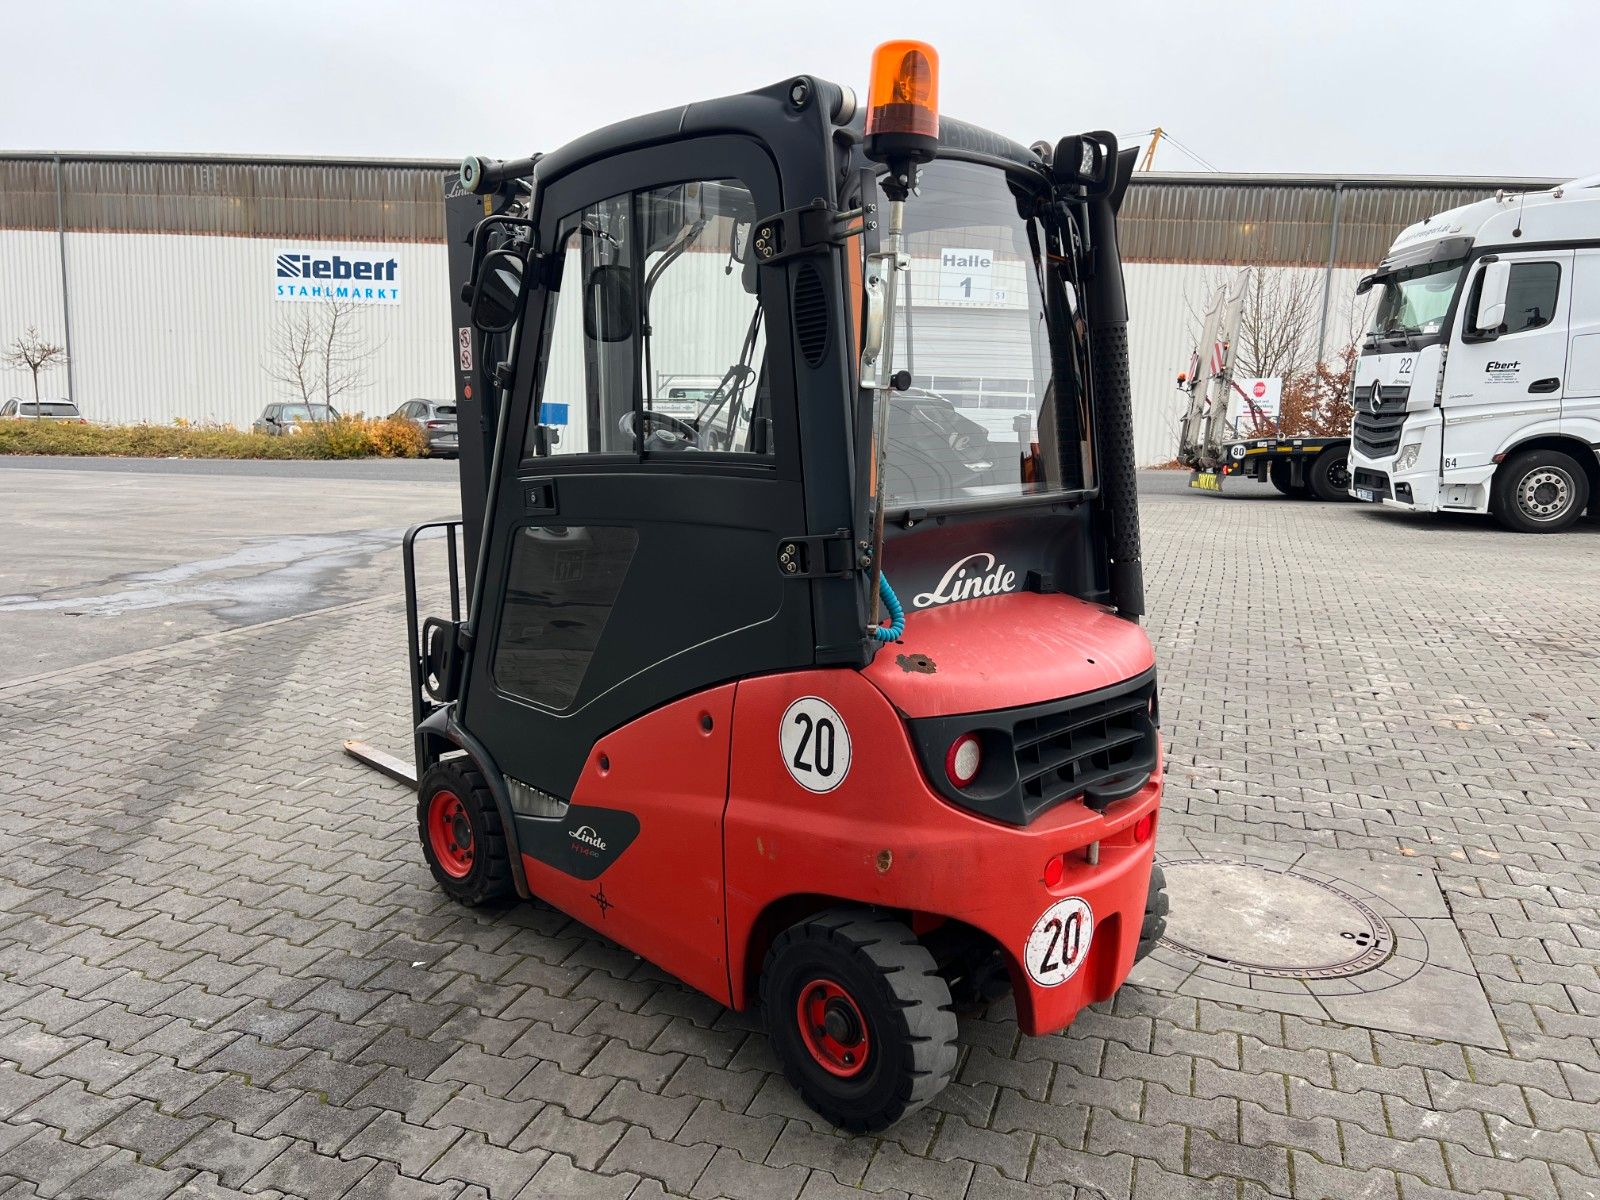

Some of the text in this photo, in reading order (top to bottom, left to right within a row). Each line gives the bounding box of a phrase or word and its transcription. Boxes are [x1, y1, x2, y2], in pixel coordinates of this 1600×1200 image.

[444, 179, 474, 199] Lin
[276, 254, 398, 281] Siebert
[943, 254, 991, 268] Halle
[277, 285, 399, 300] STAHLMARKT
[960, 277, 972, 298] 1
[1398, 357, 1413, 374] 22
[1485, 360, 1521, 373] Ebert
[1233, 447, 1245, 457] 80
[1445, 458, 1457, 468] 64
[913, 552, 1016, 608] Linde
[794, 712, 835, 777] 20
[568, 825, 607, 851] Linde
[1040, 911, 1082, 974] 20
